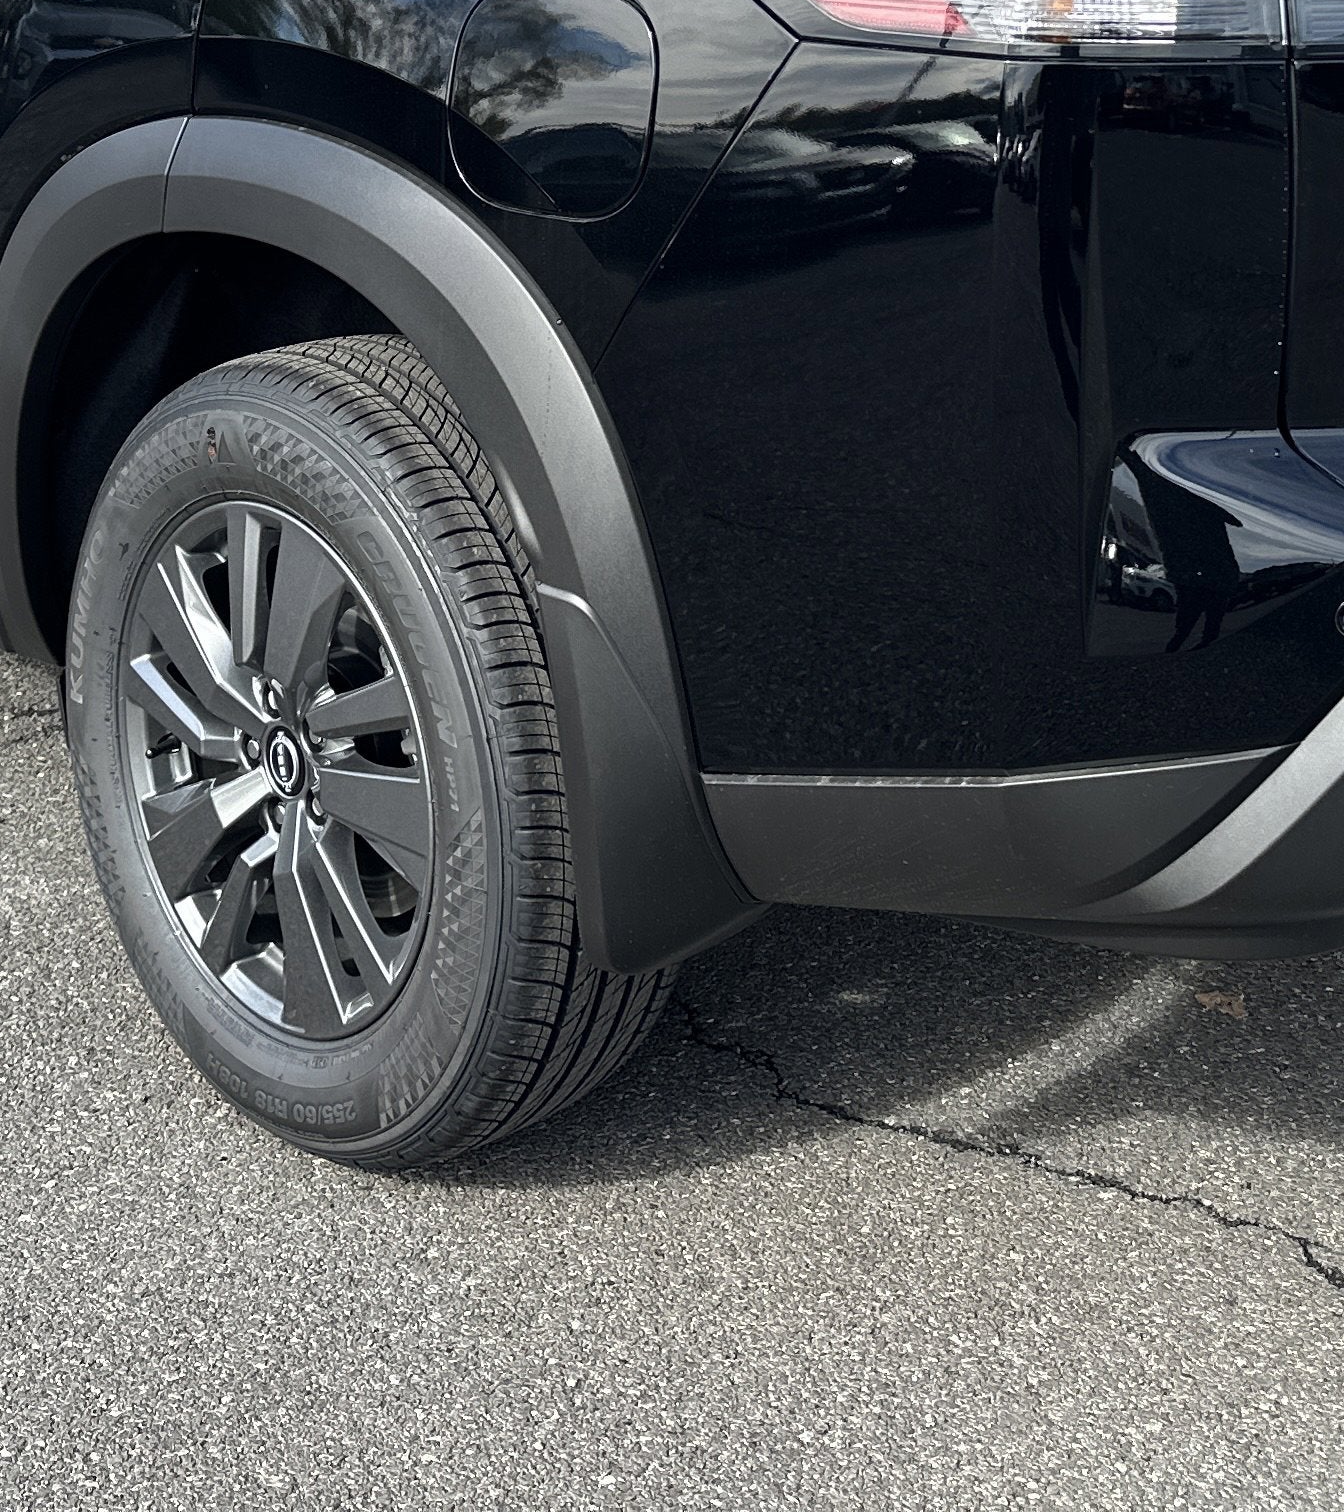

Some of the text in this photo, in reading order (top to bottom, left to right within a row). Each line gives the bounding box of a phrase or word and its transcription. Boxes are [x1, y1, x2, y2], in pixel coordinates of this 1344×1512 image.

[69, 528, 105, 705] KUMHO
[255, 1090, 289, 1119] R18
[291, 1099, 356, 1126] 255/60
